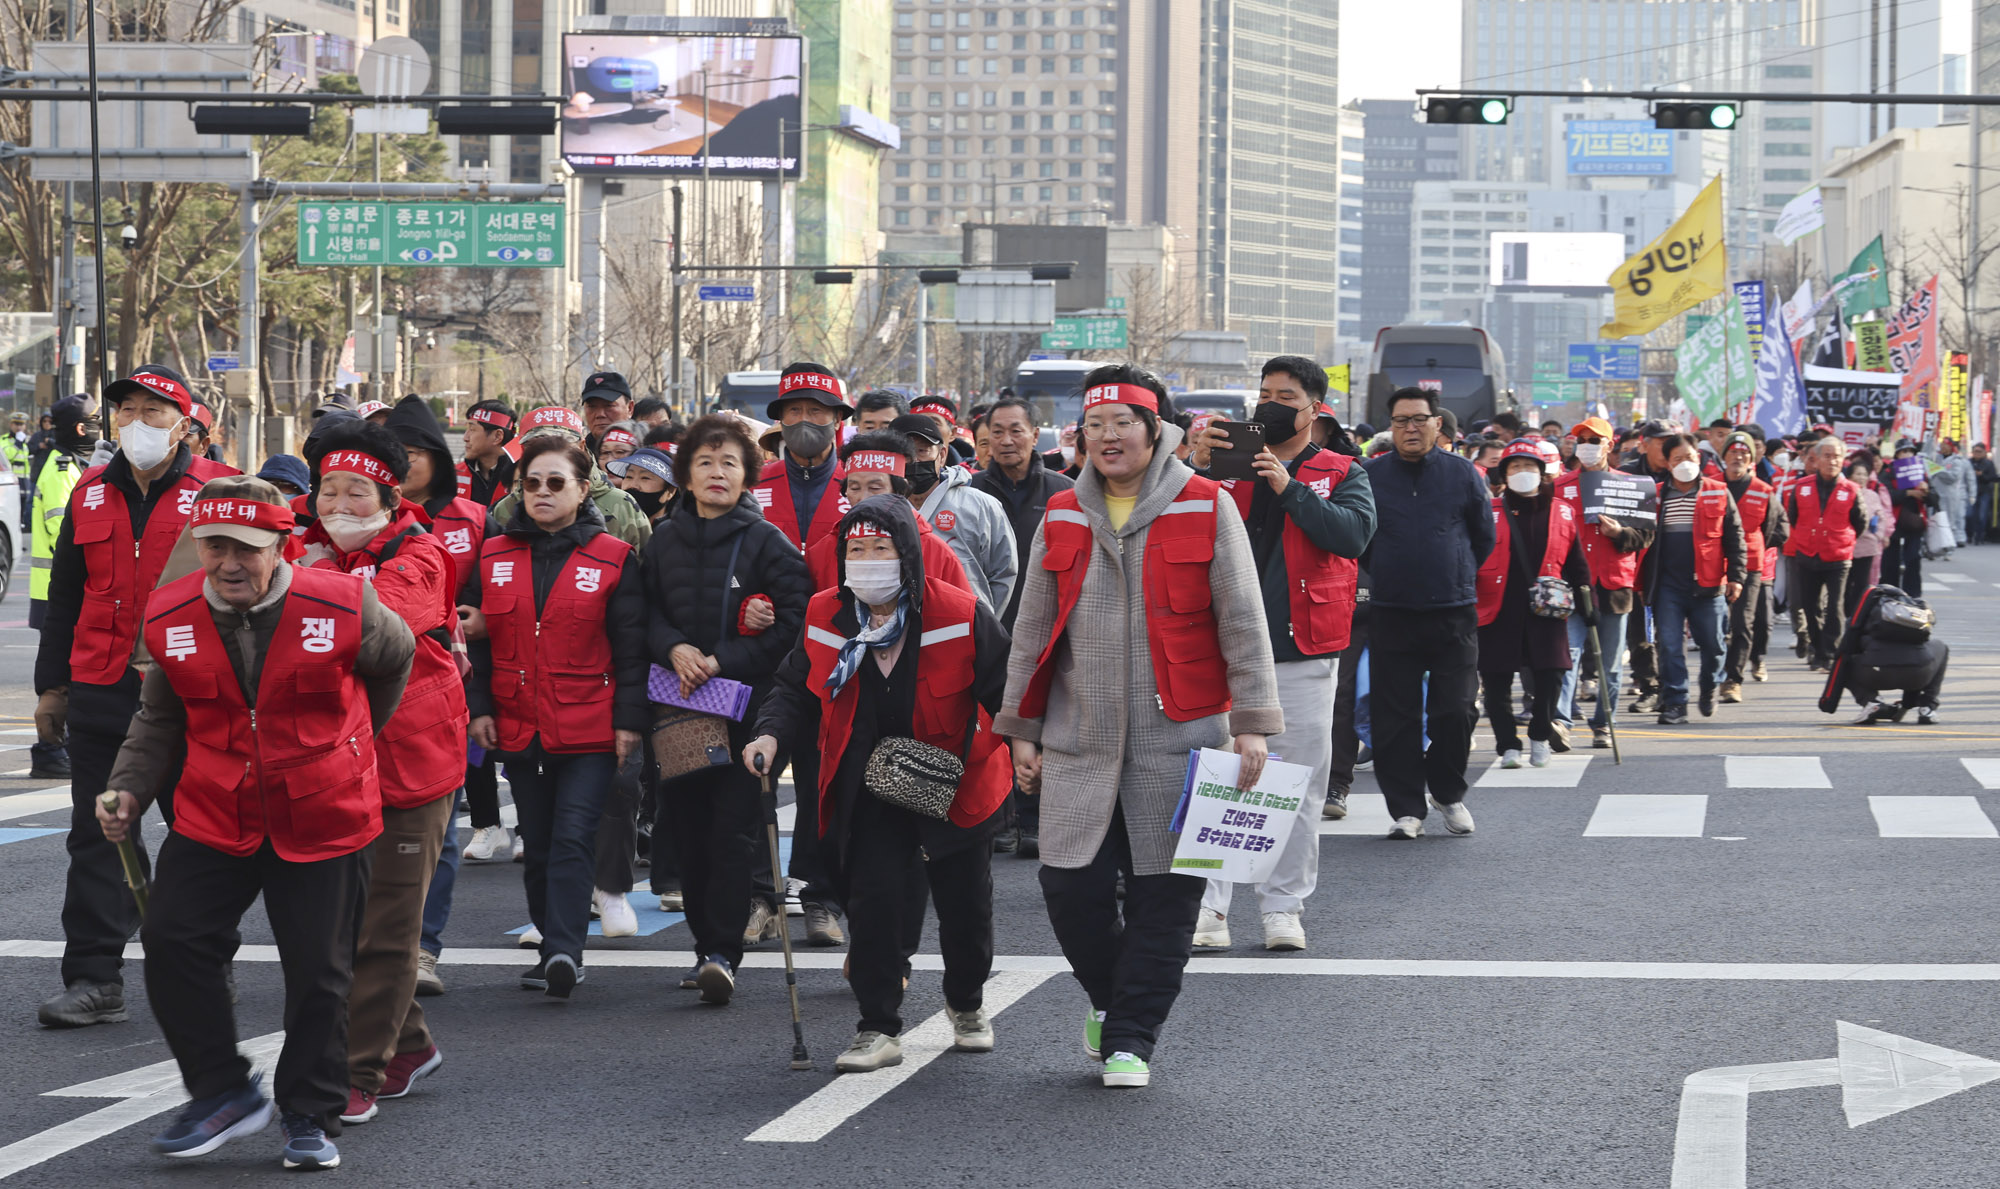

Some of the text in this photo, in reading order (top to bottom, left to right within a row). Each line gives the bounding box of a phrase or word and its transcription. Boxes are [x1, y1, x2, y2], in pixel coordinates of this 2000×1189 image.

[1570, 133, 1670, 157] 기프트인포
[326, 207, 378, 222] 숭례문
[485, 212, 556, 230] 서대문역
[326, 236, 353, 252] 시청
[397, 228, 432, 241] Jongno
[487, 231, 552, 242] Seodaemun Stn
[327, 252, 368, 263] City Hall
[418, 249, 427, 260] 6
[503, 249, 513, 260] 6
[783, 374, 833, 390] 결사반대
[533, 410, 565, 423] 송전탑
[329, 452, 394, 482] 결사반대
[853, 453, 895, 471] 결사반대
[83, 483, 105, 511] 투
[177, 488, 199, 515] 쟁
[192, 501, 257, 522] 결사반대
[845, 520, 892, 539] 사반
[443, 528, 472, 554] 쟁
[490, 561, 515, 587] 투
[574, 565, 602, 593] 쟁
[165, 624, 198, 662] 투
[301, 617, 336, 653] 쟁
[1221, 809, 1267, 830] 분산하고
[1196, 827, 1276, 853] 수도권 전력수요
